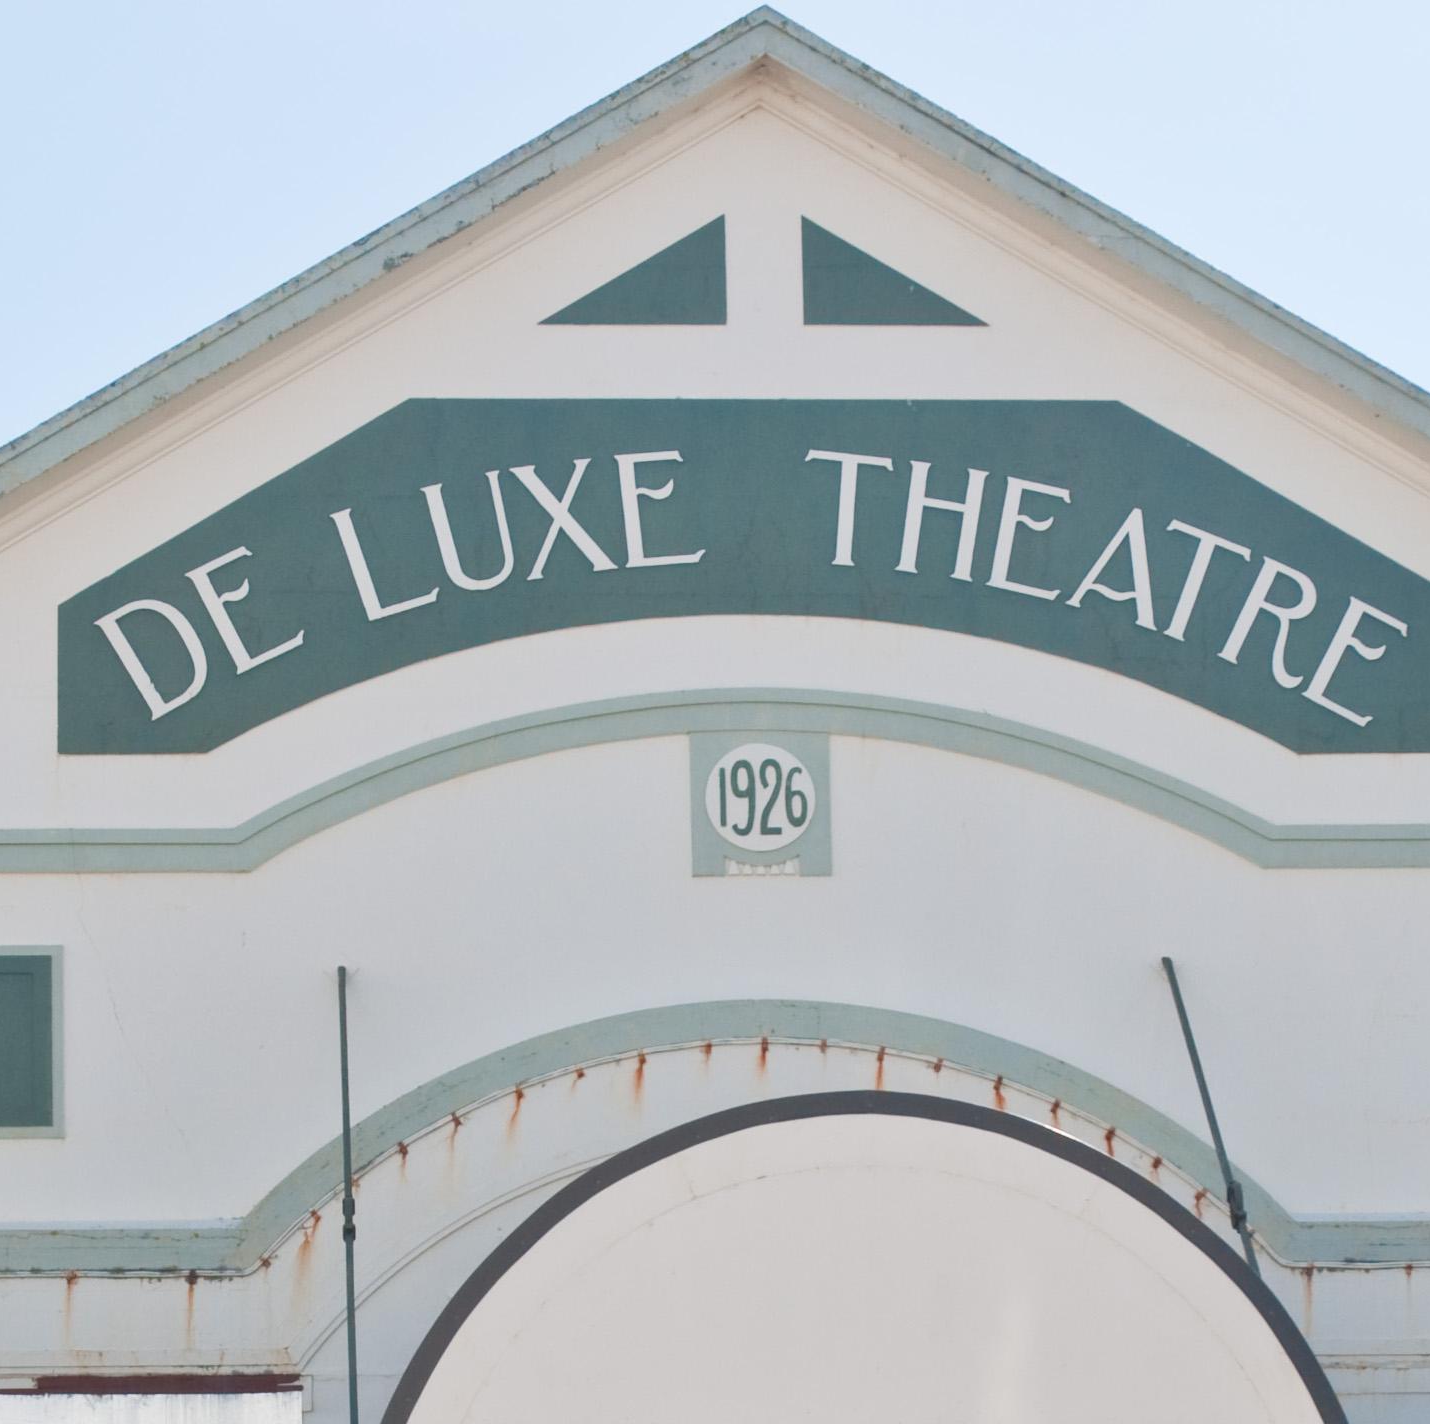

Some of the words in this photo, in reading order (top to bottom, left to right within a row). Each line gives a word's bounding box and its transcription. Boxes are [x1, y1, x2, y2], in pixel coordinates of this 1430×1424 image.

[93, 545, 305, 721] DE
[329, 450, 707, 622] LUXE
[804, 449, 1409, 727] THEATRE
[719, 758, 808, 837] 1926
